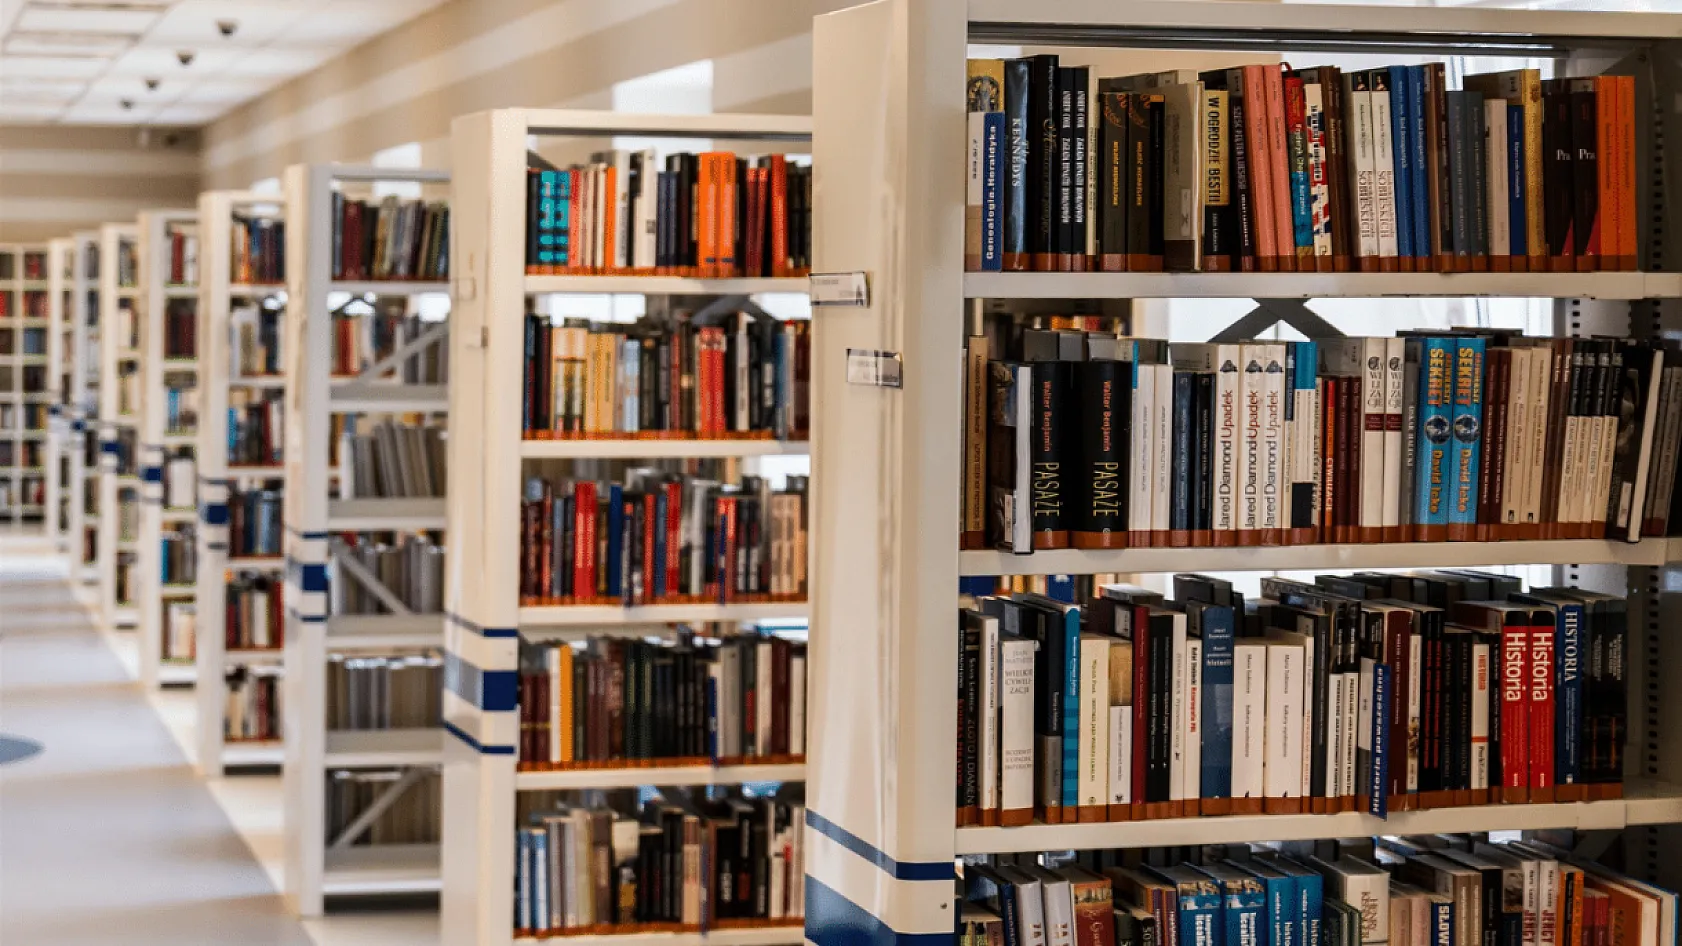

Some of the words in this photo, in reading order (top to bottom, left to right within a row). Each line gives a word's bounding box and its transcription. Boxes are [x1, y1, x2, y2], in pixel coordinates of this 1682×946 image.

[1208, 97, 1220, 108] W
[1011, 118, 1021, 187] KENNEDYS
[1208, 111, 1220, 165] OGRODZIE
[1208, 168, 1220, 202] BESTII
[1358, 170, 1370, 238] SOBIESKICH
[1378, 170, 1389, 238] SOBIESKICH
[1043, 381, 1053, 408] Walter
[1103, 380, 1113, 408] Walter
[1370, 389, 1382, 398] ZA
[1427, 348, 1445, 407] SEKRET
[1456, 347, 1474, 407] SEKRET
[1042, 411, 1054, 452] Benjamin
[1101, 411, 1113, 451] Benjamin
[1220, 391, 1236, 439] Upadek
[1245, 391, 1260, 439] Upadek
[1266, 391, 1281, 439] Upadek
[1408, 405, 1416, 431] OSKAR
[1034, 461, 1062, 517] PASAŻE
[1093, 461, 1121, 517] PASAŻE
[1218, 441, 1232, 496] Diamond
[1243, 441, 1257, 496] Diamond
[1263, 441, 1278, 496] Diamond
[1326, 457, 1334, 511] CYWILIZACJE
[1430, 449, 1443, 484] David
[1459, 448, 1472, 482] David
[1218, 497, 1231, 531] Jared
[1244, 498, 1256, 531] Jared
[1263, 498, 1277, 530] Jared
[1429, 487, 1441, 514] Icke
[1458, 485, 1470, 512] Icke
[1505, 632, 1527, 702] Historia
[1532, 632, 1553, 702] Historia
[1564, 611, 1578, 682] HISTORIA
[1373, 667, 1386, 755] powszechna
[1371, 757, 1383, 813] Historia
[1368, 899, 1379, 931] HENRY
[1438, 905, 1450, 946] SŁOW
